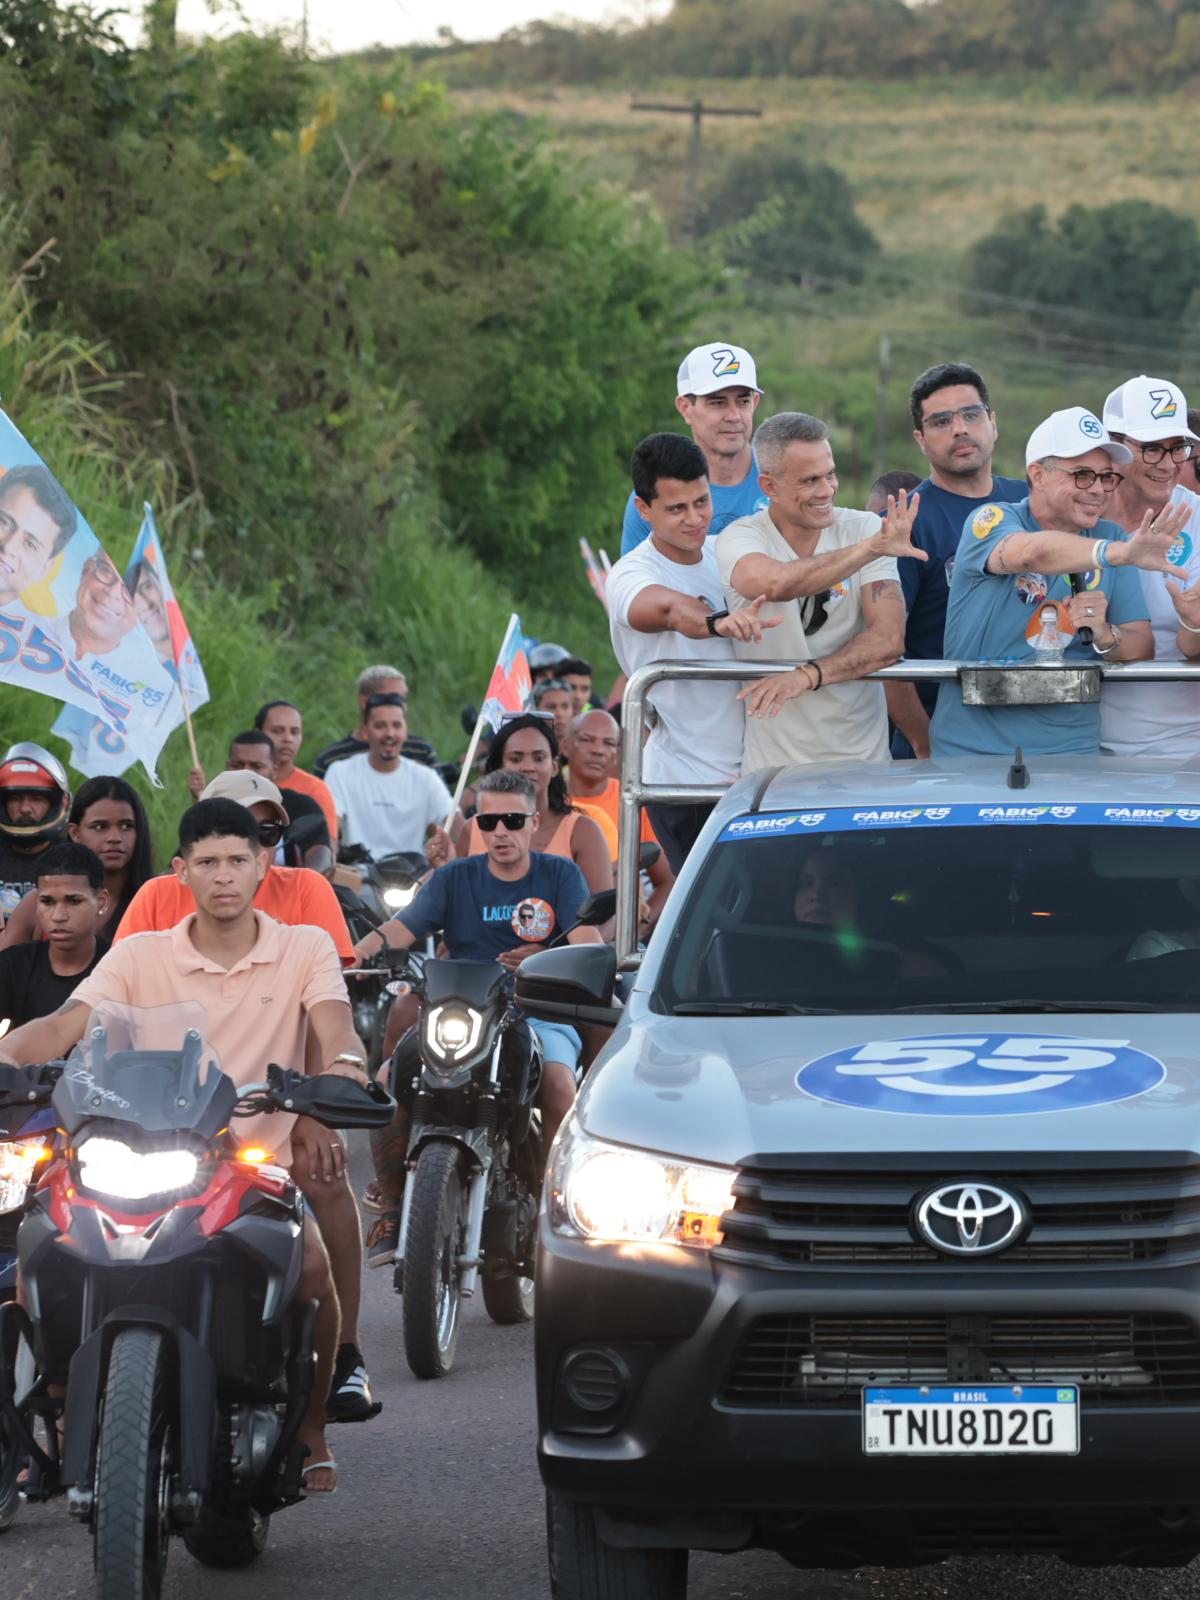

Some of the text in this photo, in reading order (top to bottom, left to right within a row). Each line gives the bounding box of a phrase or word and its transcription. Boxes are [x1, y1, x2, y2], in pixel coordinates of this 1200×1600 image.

[1083, 420, 1100, 434] 55
[142, 685, 165, 704] 55
[852, 807, 952, 821] FABIO 55
[978, 806, 1078, 817] FABIO 55
[1104, 807, 1174, 818] FABIO
[728, 815, 798, 832] FABIO
[799, 813, 827, 823] 55
[834, 1037, 1131, 1076] 55
[953, 1391, 989, 1402] BRASIL
[882, 1409, 1053, 1446] TNU8D20
